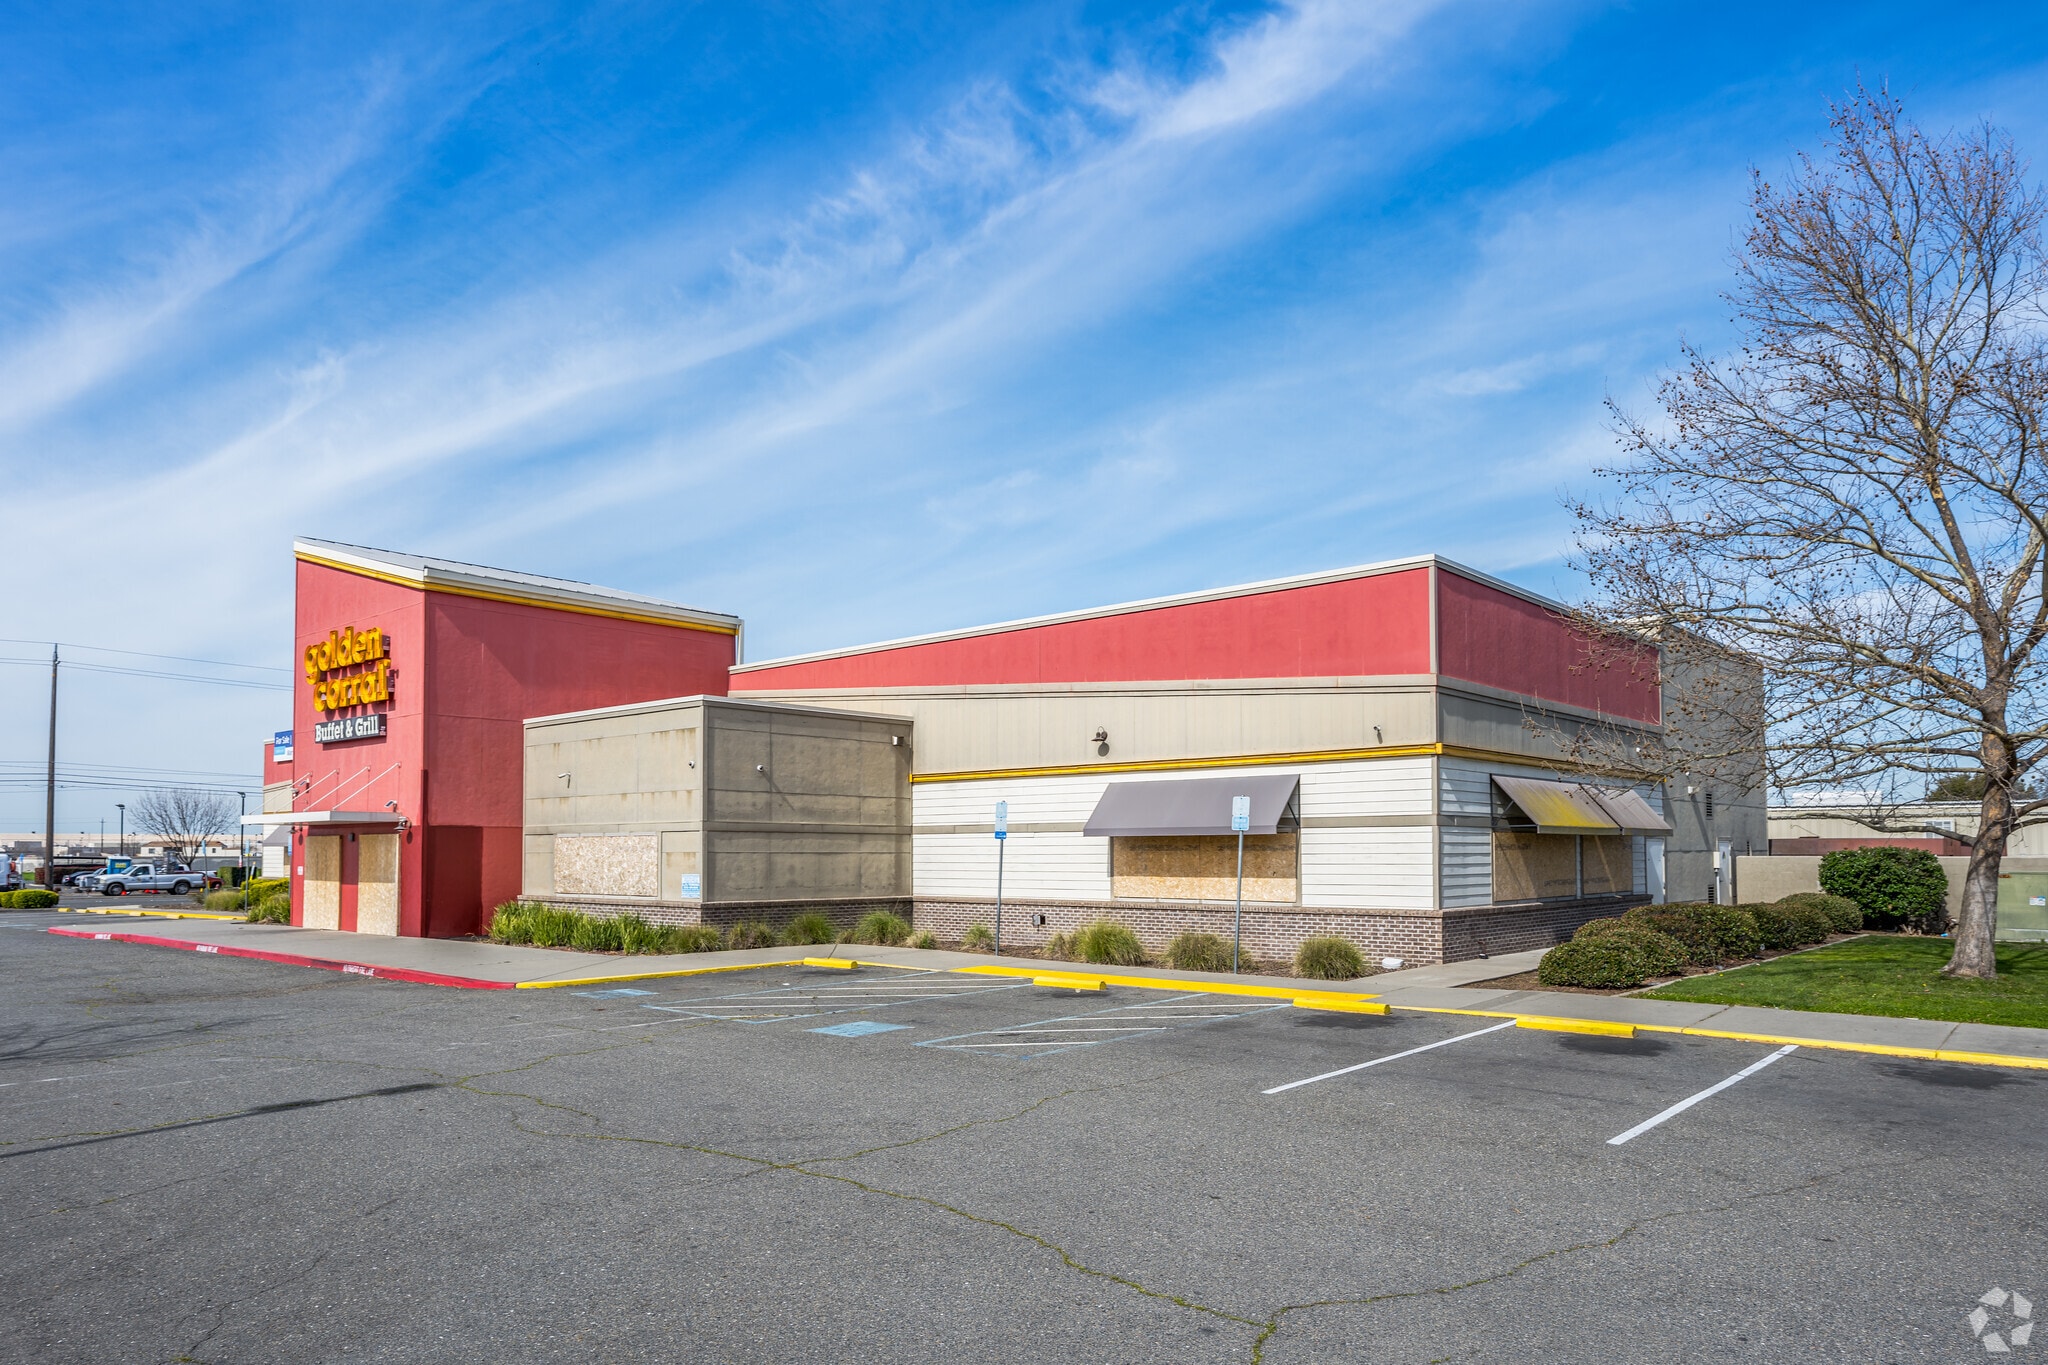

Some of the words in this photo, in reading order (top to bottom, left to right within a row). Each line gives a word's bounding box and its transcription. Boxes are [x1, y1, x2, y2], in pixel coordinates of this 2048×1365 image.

[315, 720, 344, 742] Buffet
[345, 718, 353, 738] &
[355, 715, 379, 736] Grill
